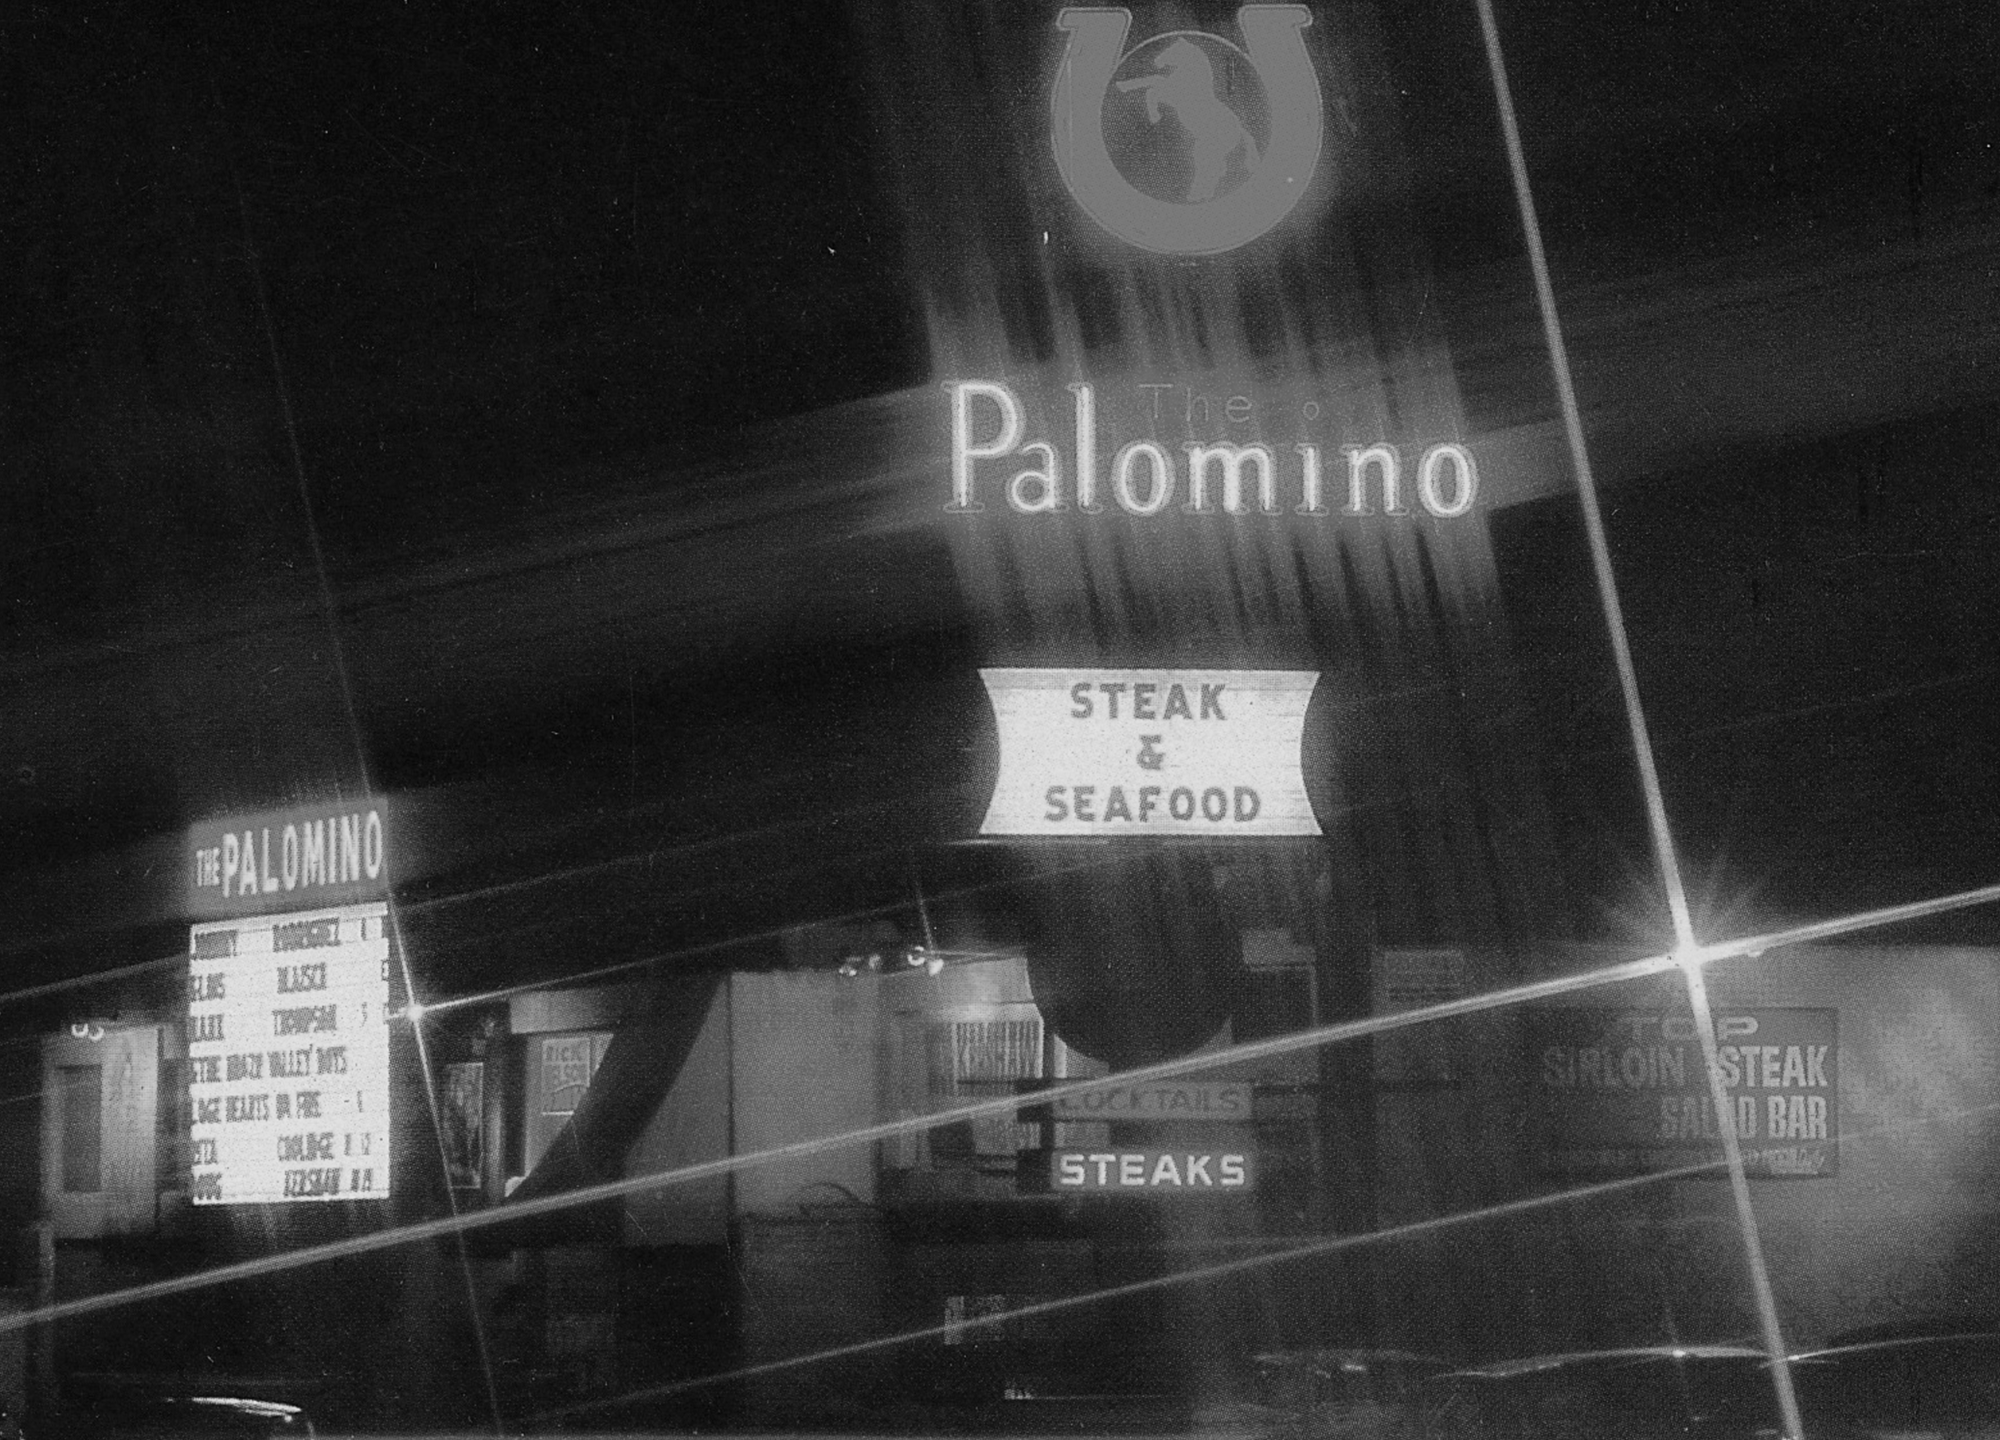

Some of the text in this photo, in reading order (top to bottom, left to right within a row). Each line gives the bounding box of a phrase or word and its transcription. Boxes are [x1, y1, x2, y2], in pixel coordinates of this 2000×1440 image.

[1138, 383, 1253, 423] The
[940, 378, 1480, 517] Palomino
[1070, 681, 1228, 721] STEAK
[1135, 733, 1168, 771] &
[1044, 784, 1262, 824] SEAFOOD
[196, 809, 384, 899] THE PALOMINO
[1622, 1015, 1760, 1042] TOP
[1543, 1045, 1829, 1089] SIRLOIN STEAK
[1766, 1095, 1828, 1140] BAR
[1059, 1153, 1246, 1187] STEAKS
